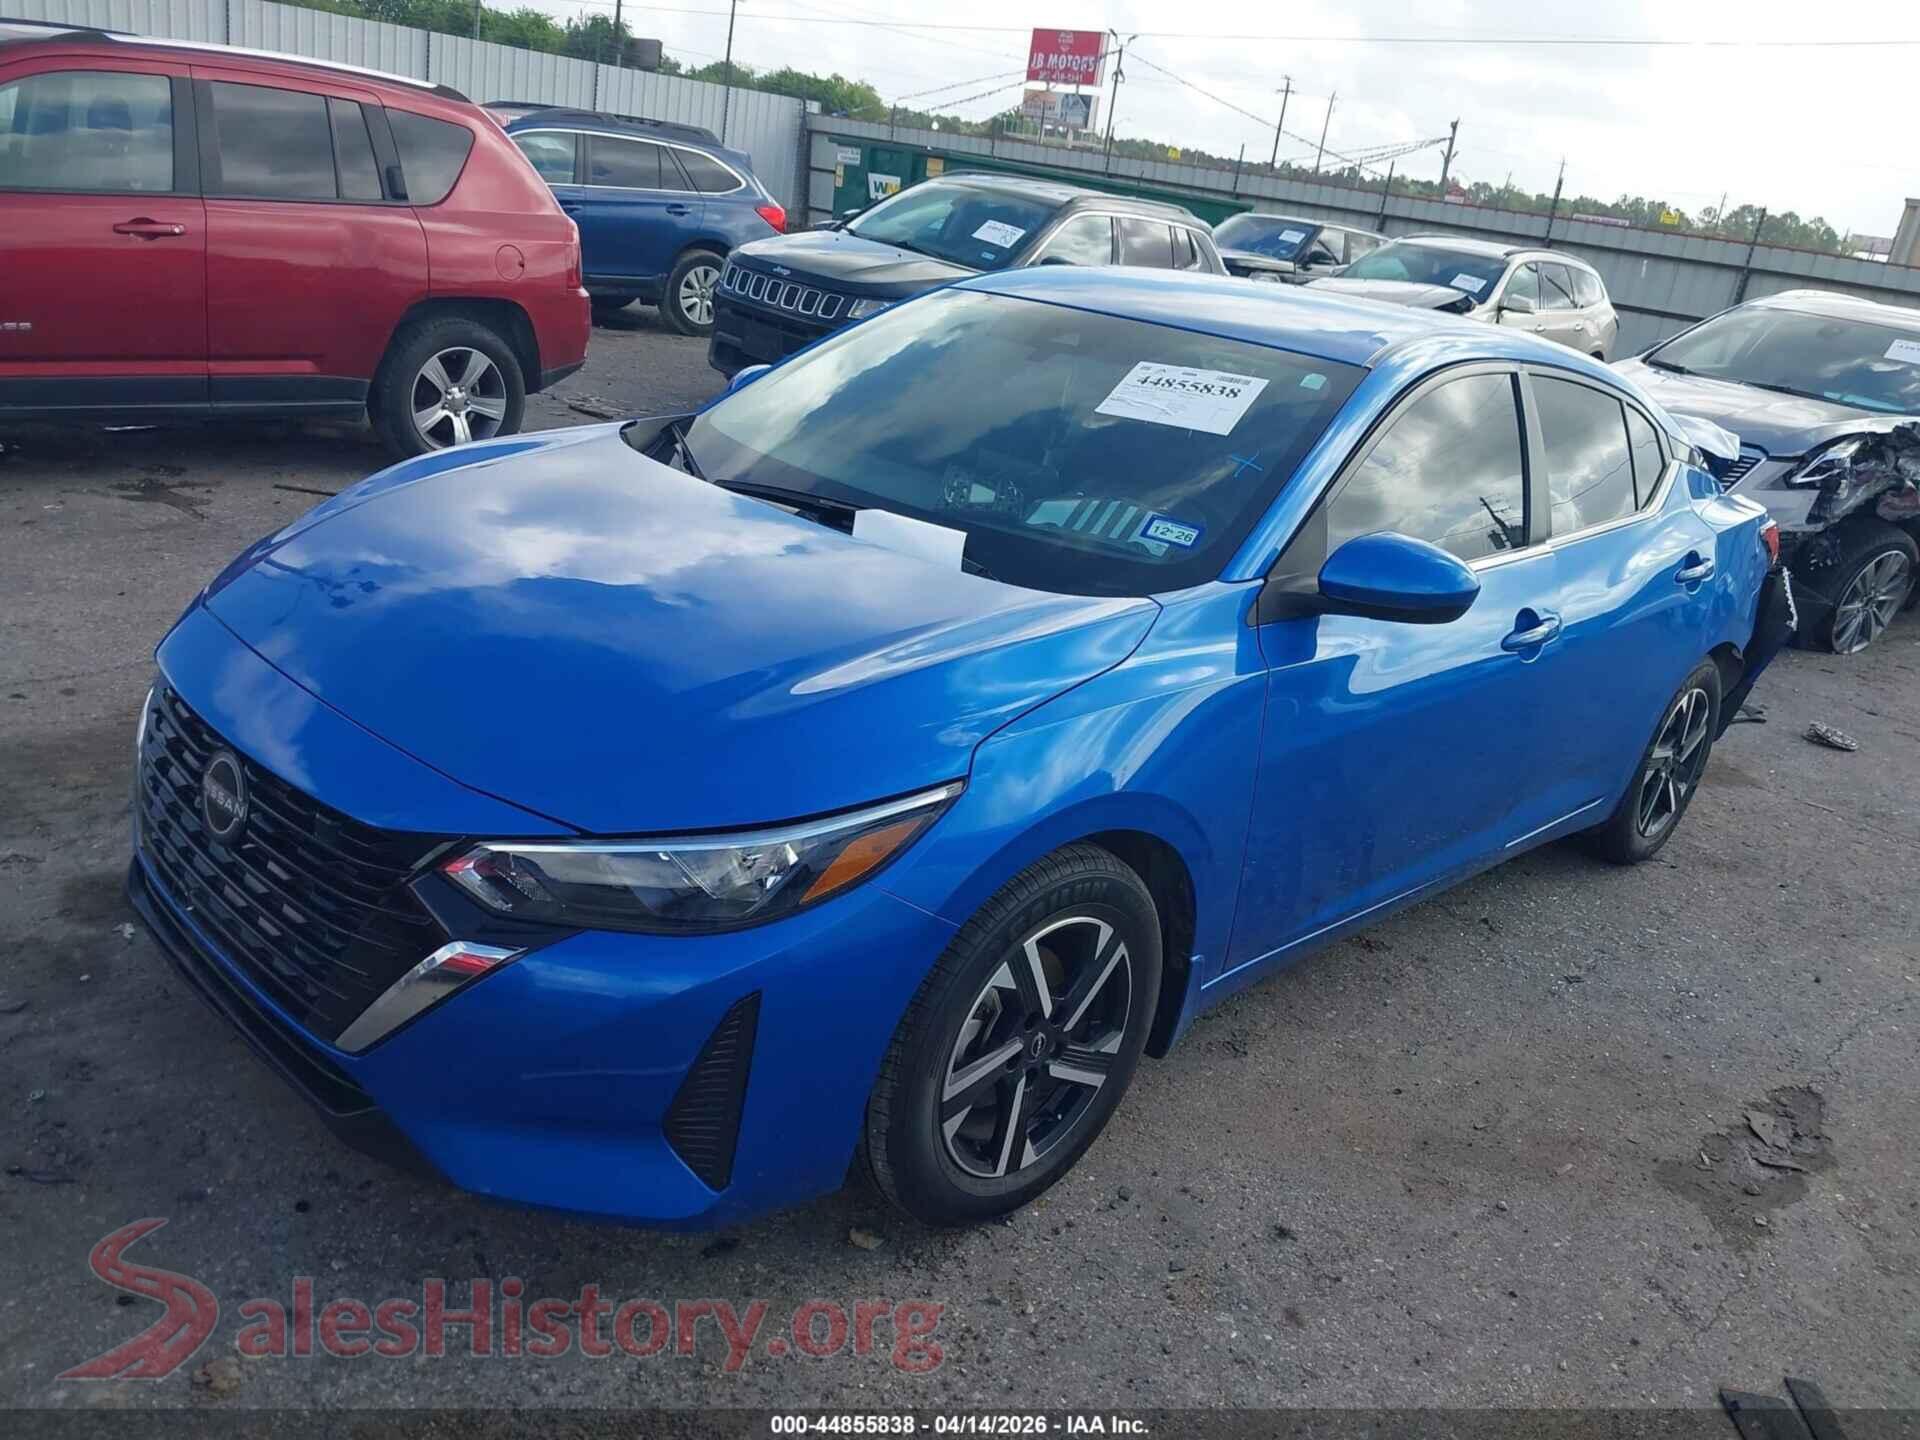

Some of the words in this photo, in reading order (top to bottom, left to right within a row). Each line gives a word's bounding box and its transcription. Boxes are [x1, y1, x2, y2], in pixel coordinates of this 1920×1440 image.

[1030, 52, 1045, 69] JB
[1047, 53, 1096, 72] MOTORS
[1136, 374, 1241, 399] 44855838
